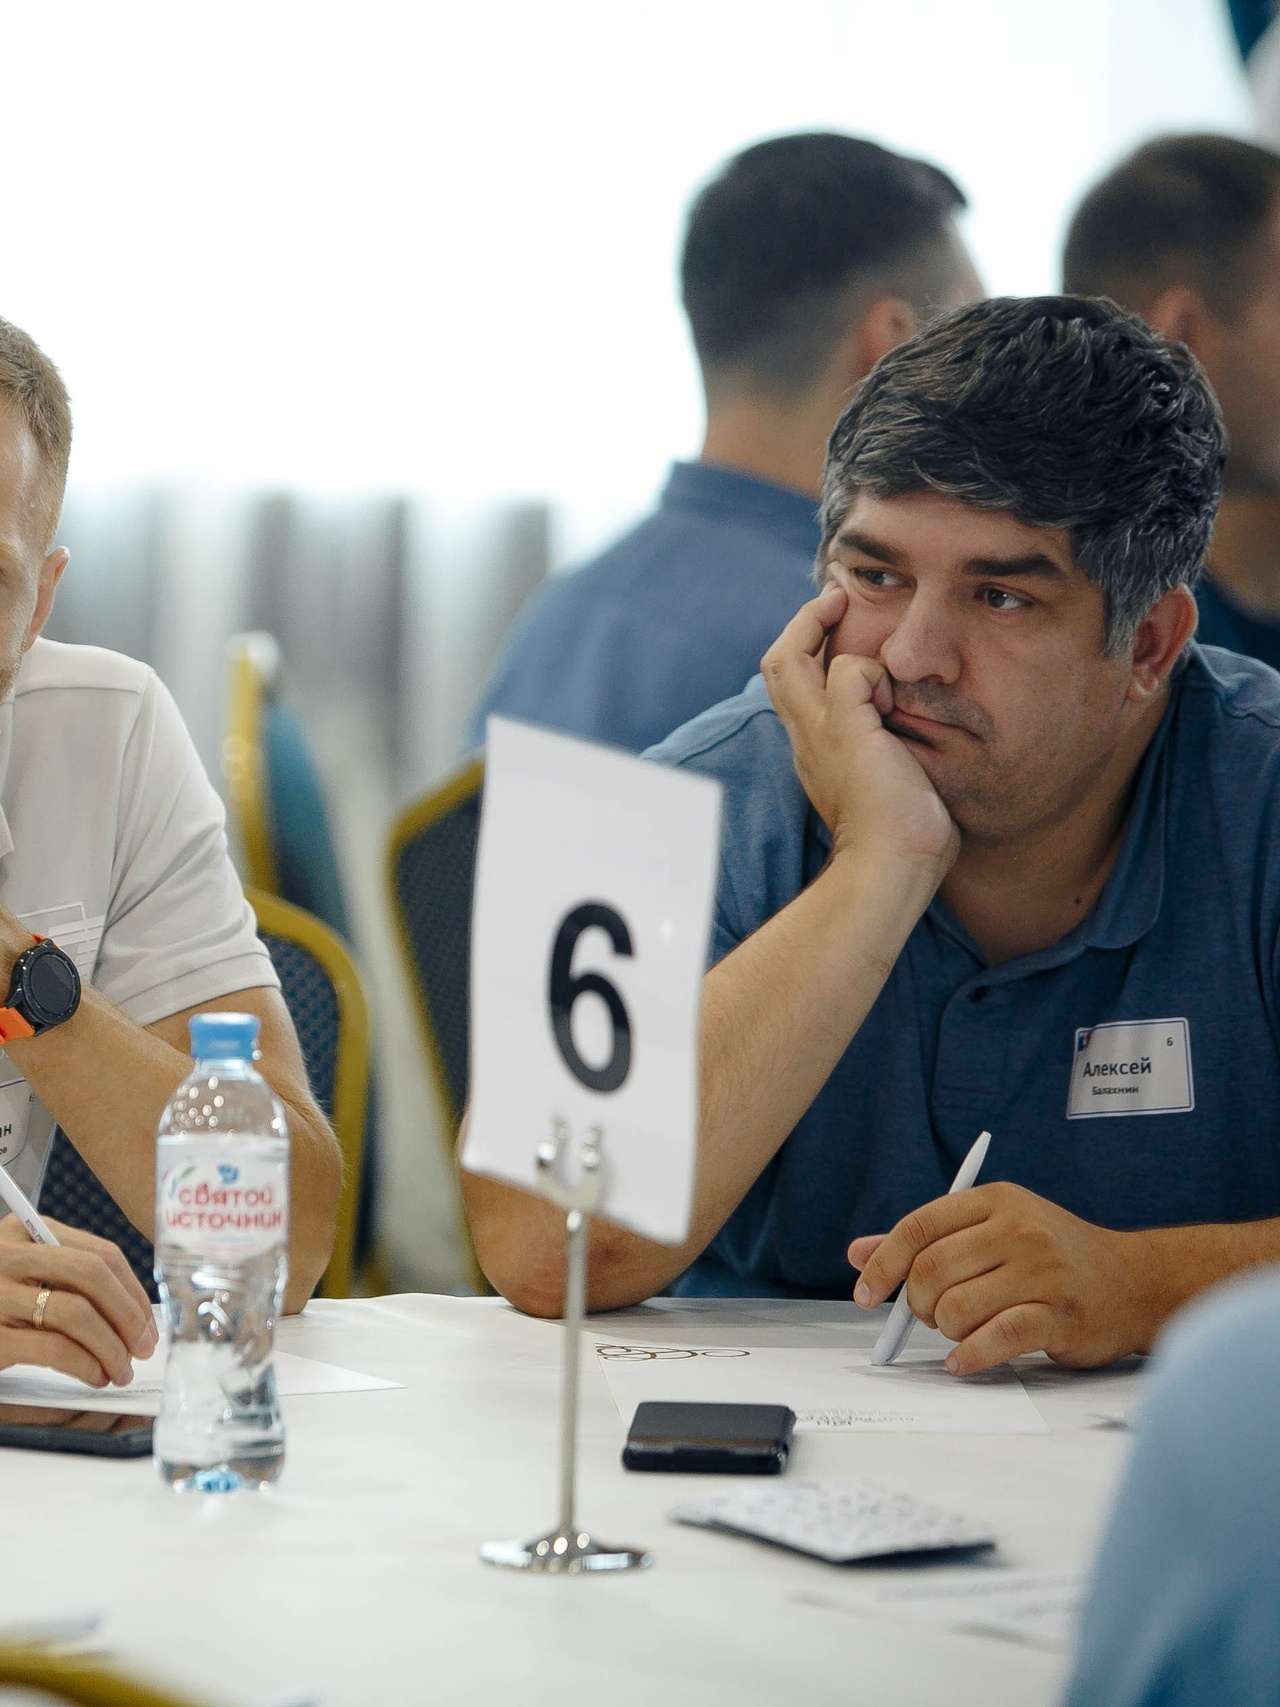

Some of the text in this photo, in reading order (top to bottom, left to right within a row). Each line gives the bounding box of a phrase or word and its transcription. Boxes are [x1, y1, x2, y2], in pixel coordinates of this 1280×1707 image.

[547, 902, 634, 1093] 6
[1166, 1036, 1174, 1046] 6
[1083, 1057, 1152, 1077] Алексей
